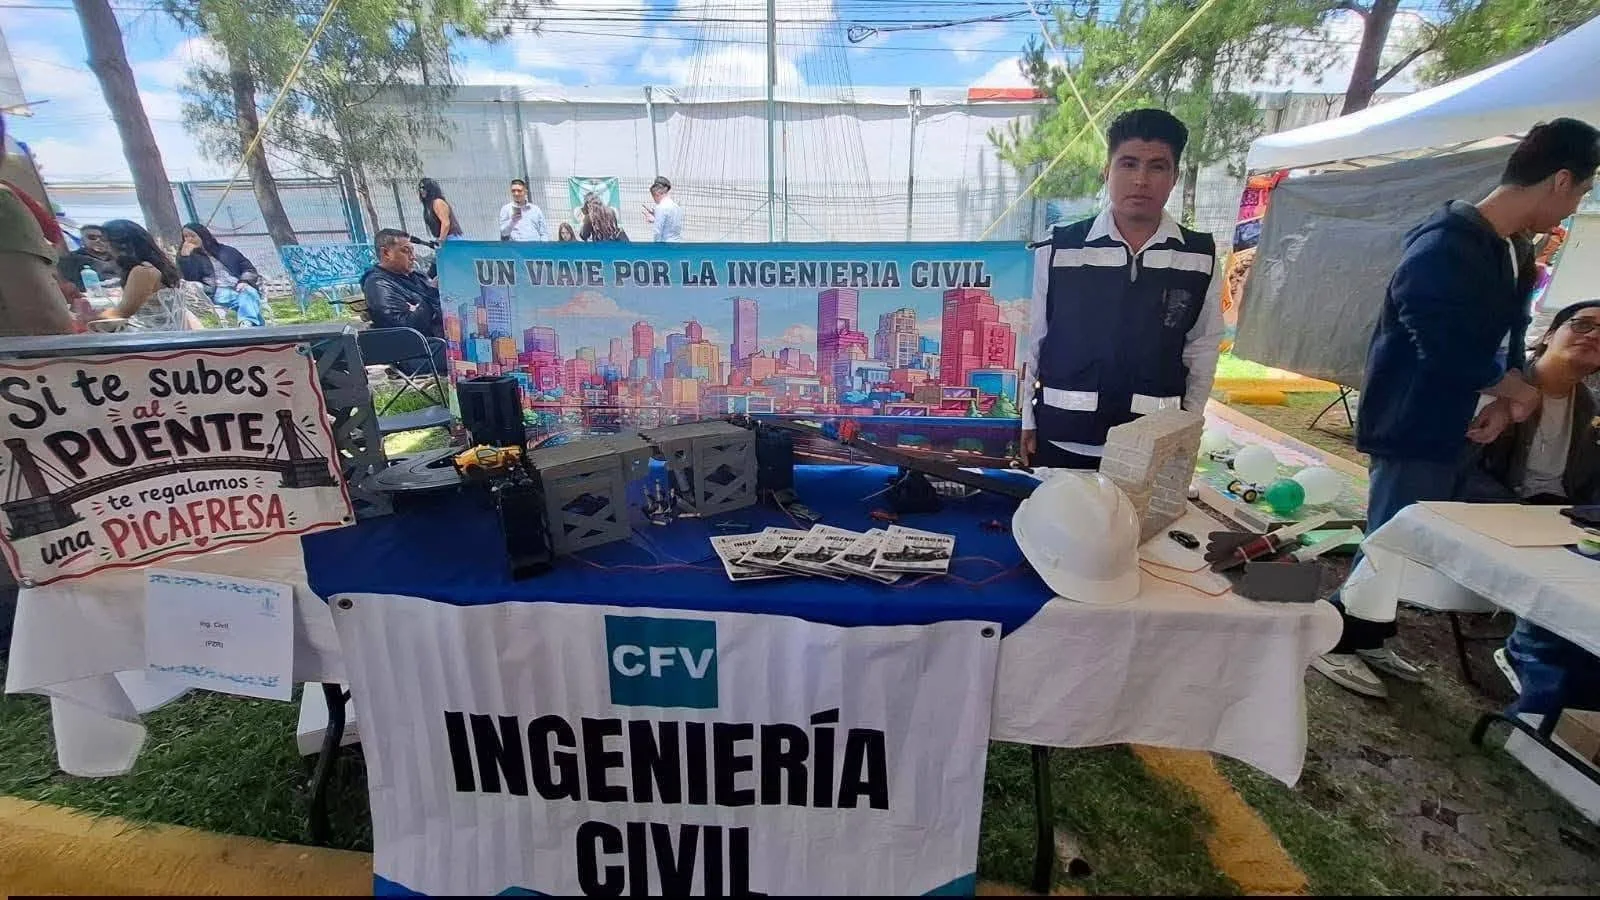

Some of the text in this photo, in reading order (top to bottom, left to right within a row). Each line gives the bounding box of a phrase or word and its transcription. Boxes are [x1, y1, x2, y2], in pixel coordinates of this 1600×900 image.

[474, 259, 992, 288] UN VIAJE POR LA INGENIERIA CIVIL
[0, 358, 268, 429] Si te subes
[133, 400, 166, 418] al
[44, 412, 276, 479] PUENTE,
[108, 475, 249, 511] te regalamos
[41, 530, 95, 565] una
[612, 644, 716, 679] CFV
[444, 707, 889, 810] INGENIERÍA
[576, 820, 769, 896] CIVIL
